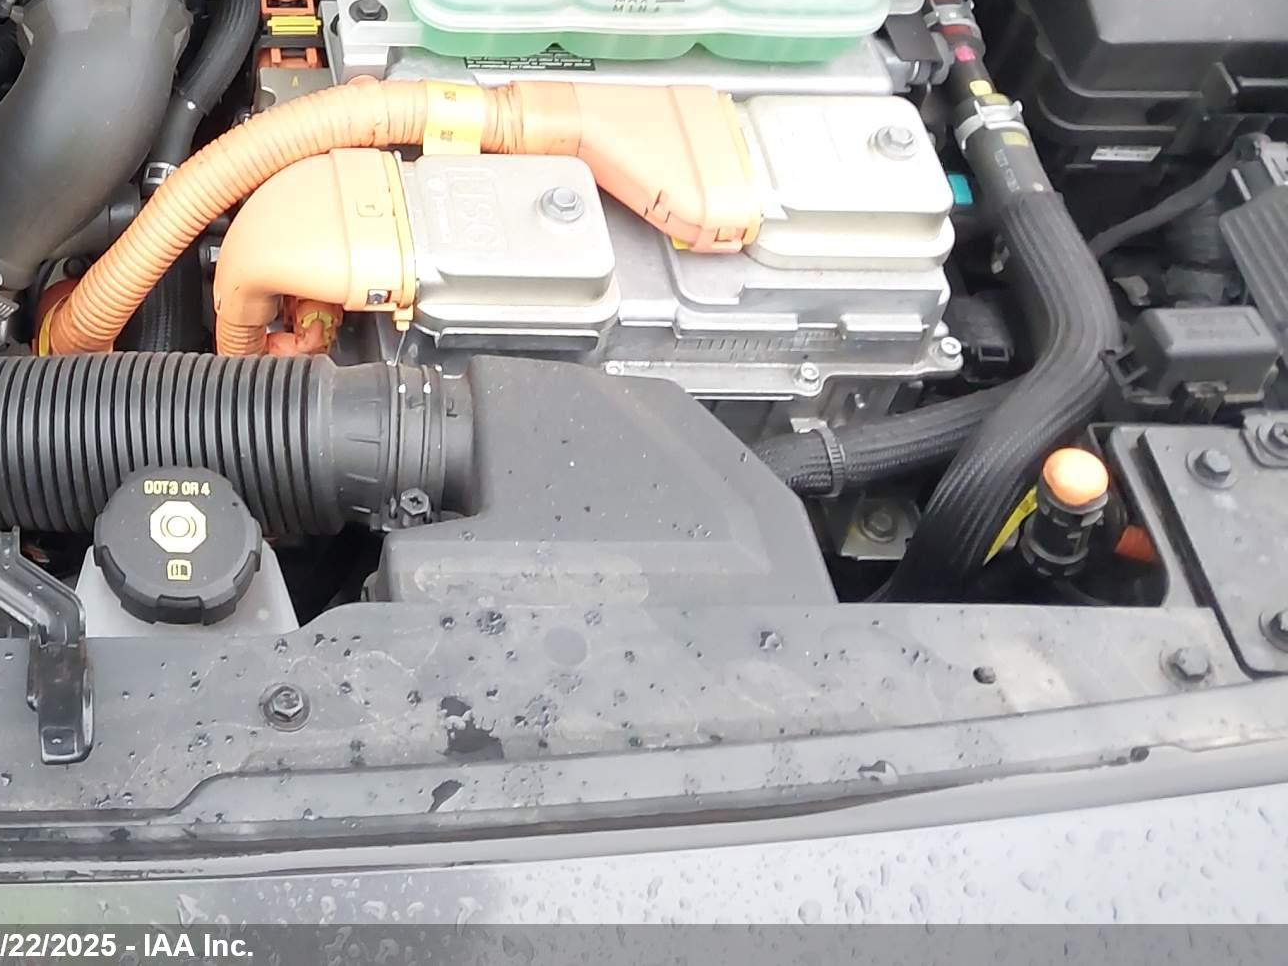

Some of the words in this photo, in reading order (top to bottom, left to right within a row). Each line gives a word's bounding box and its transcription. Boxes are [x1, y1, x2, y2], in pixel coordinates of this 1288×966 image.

[612, 4, 648, 14] MIN
[143, 479, 179, 495] DOT3
[181, 481, 199, 495] OR
[200, 482, 211, 496] 4
